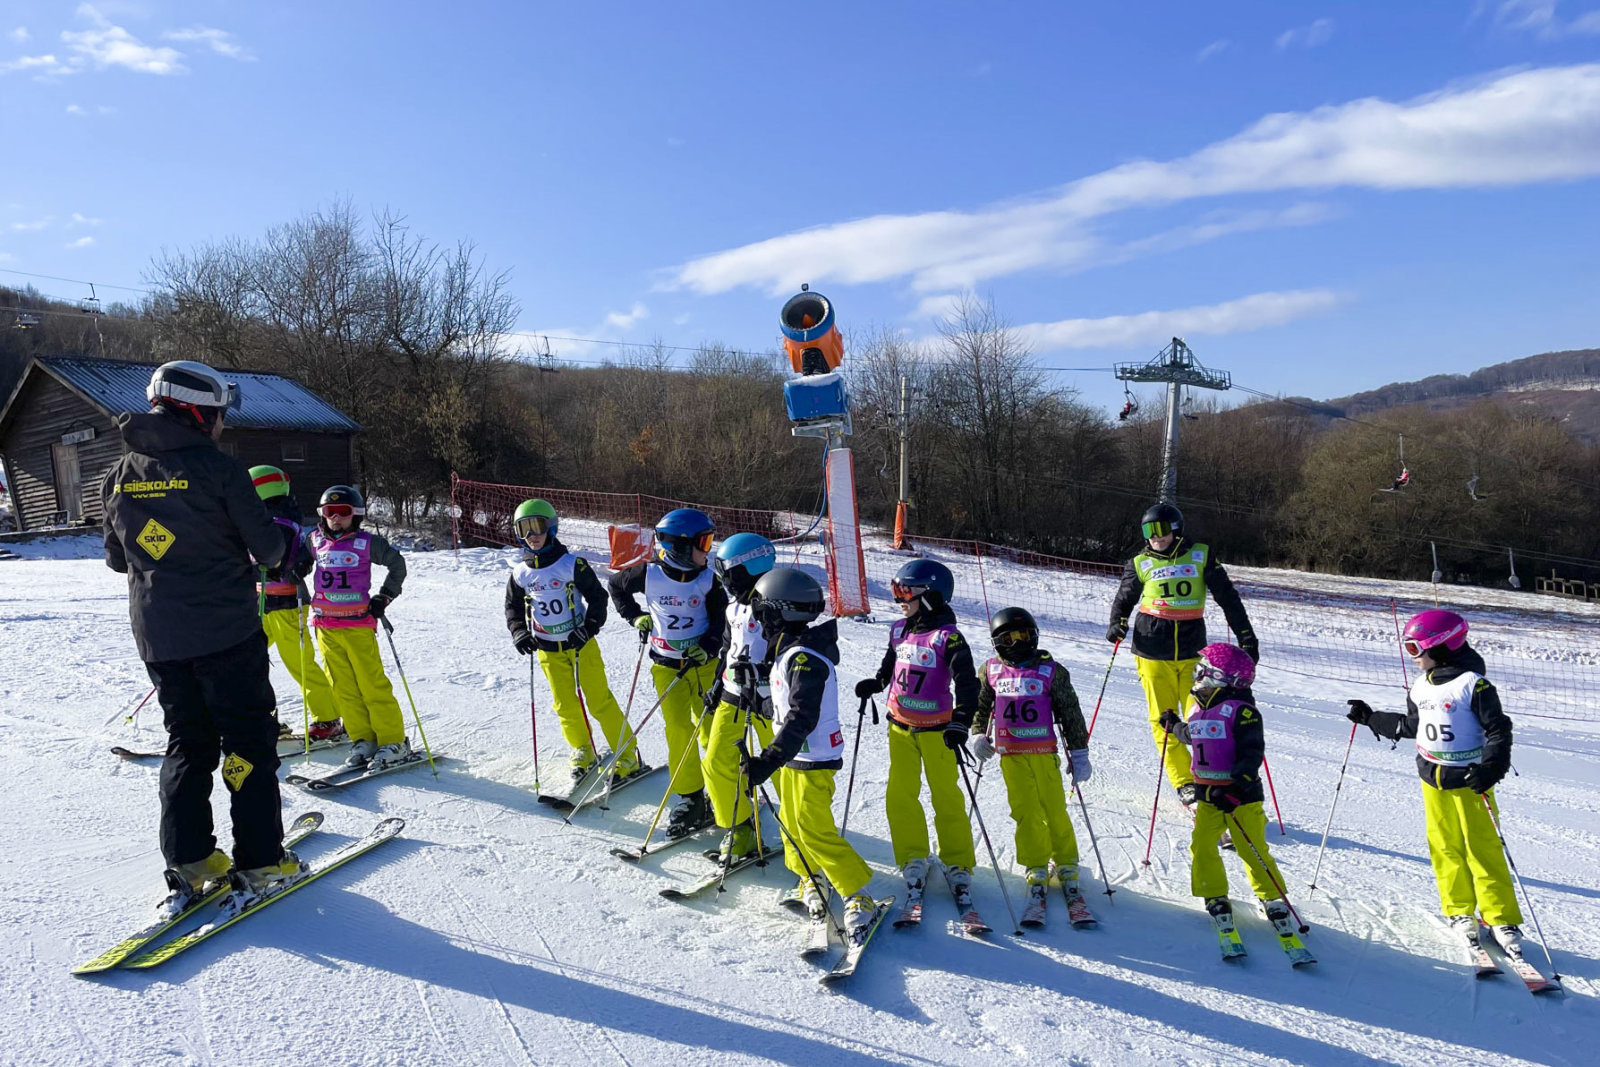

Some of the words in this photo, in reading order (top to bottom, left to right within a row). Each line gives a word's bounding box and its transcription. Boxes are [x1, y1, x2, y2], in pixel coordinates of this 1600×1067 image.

[321, 570, 351, 590] 91
[330, 593, 362, 601] HUNGARY
[1159, 580, 1192, 598] 10
[538, 599, 563, 616] 30
[667, 615, 695, 630] 22
[896, 668, 927, 694] 47
[903, 698, 937, 709] HUNGARY
[1003, 700, 1038, 723] 46
[1016, 728, 1047, 736] HUNGARY
[1425, 723, 1455, 742] 05
